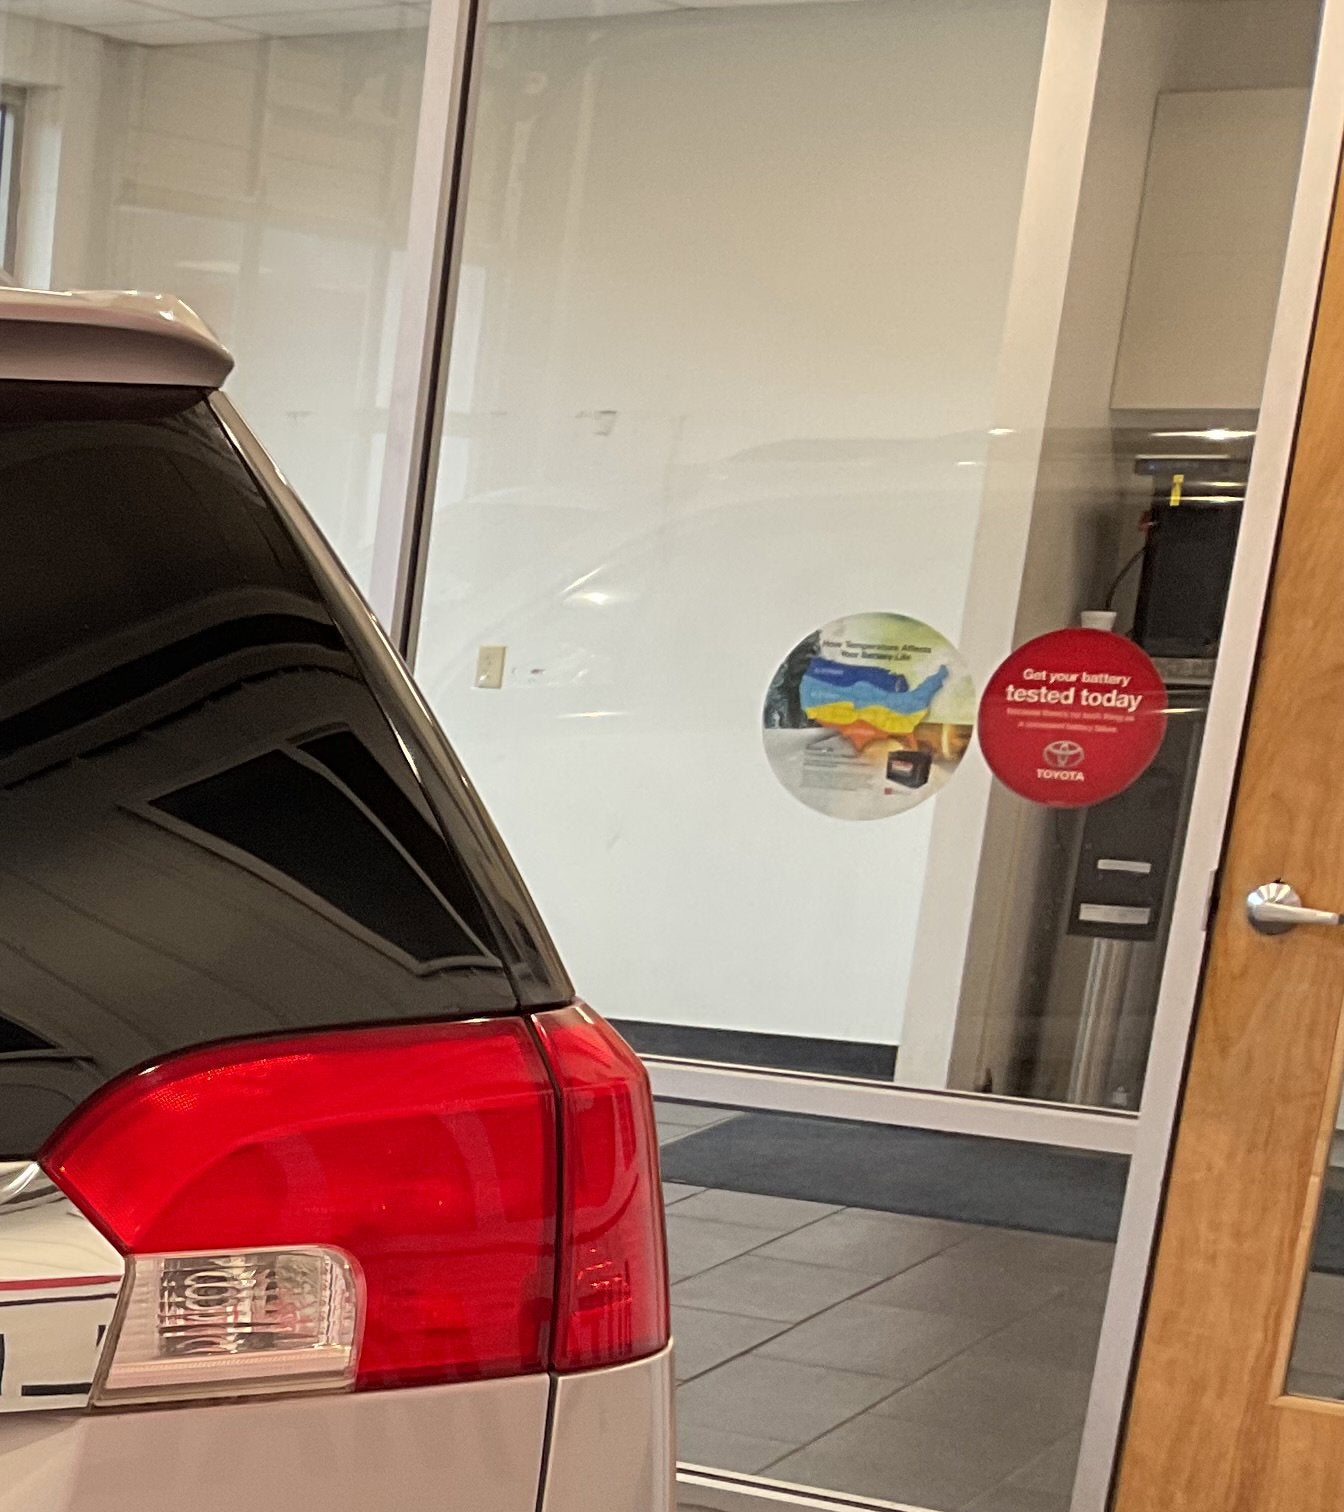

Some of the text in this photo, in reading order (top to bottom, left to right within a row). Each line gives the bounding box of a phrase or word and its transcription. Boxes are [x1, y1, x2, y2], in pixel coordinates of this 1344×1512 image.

[1023, 668, 1132, 688] Get your battery
[1005, 684, 1144, 713] tested today
[1036, 768, 1085, 782] TOYOTA
